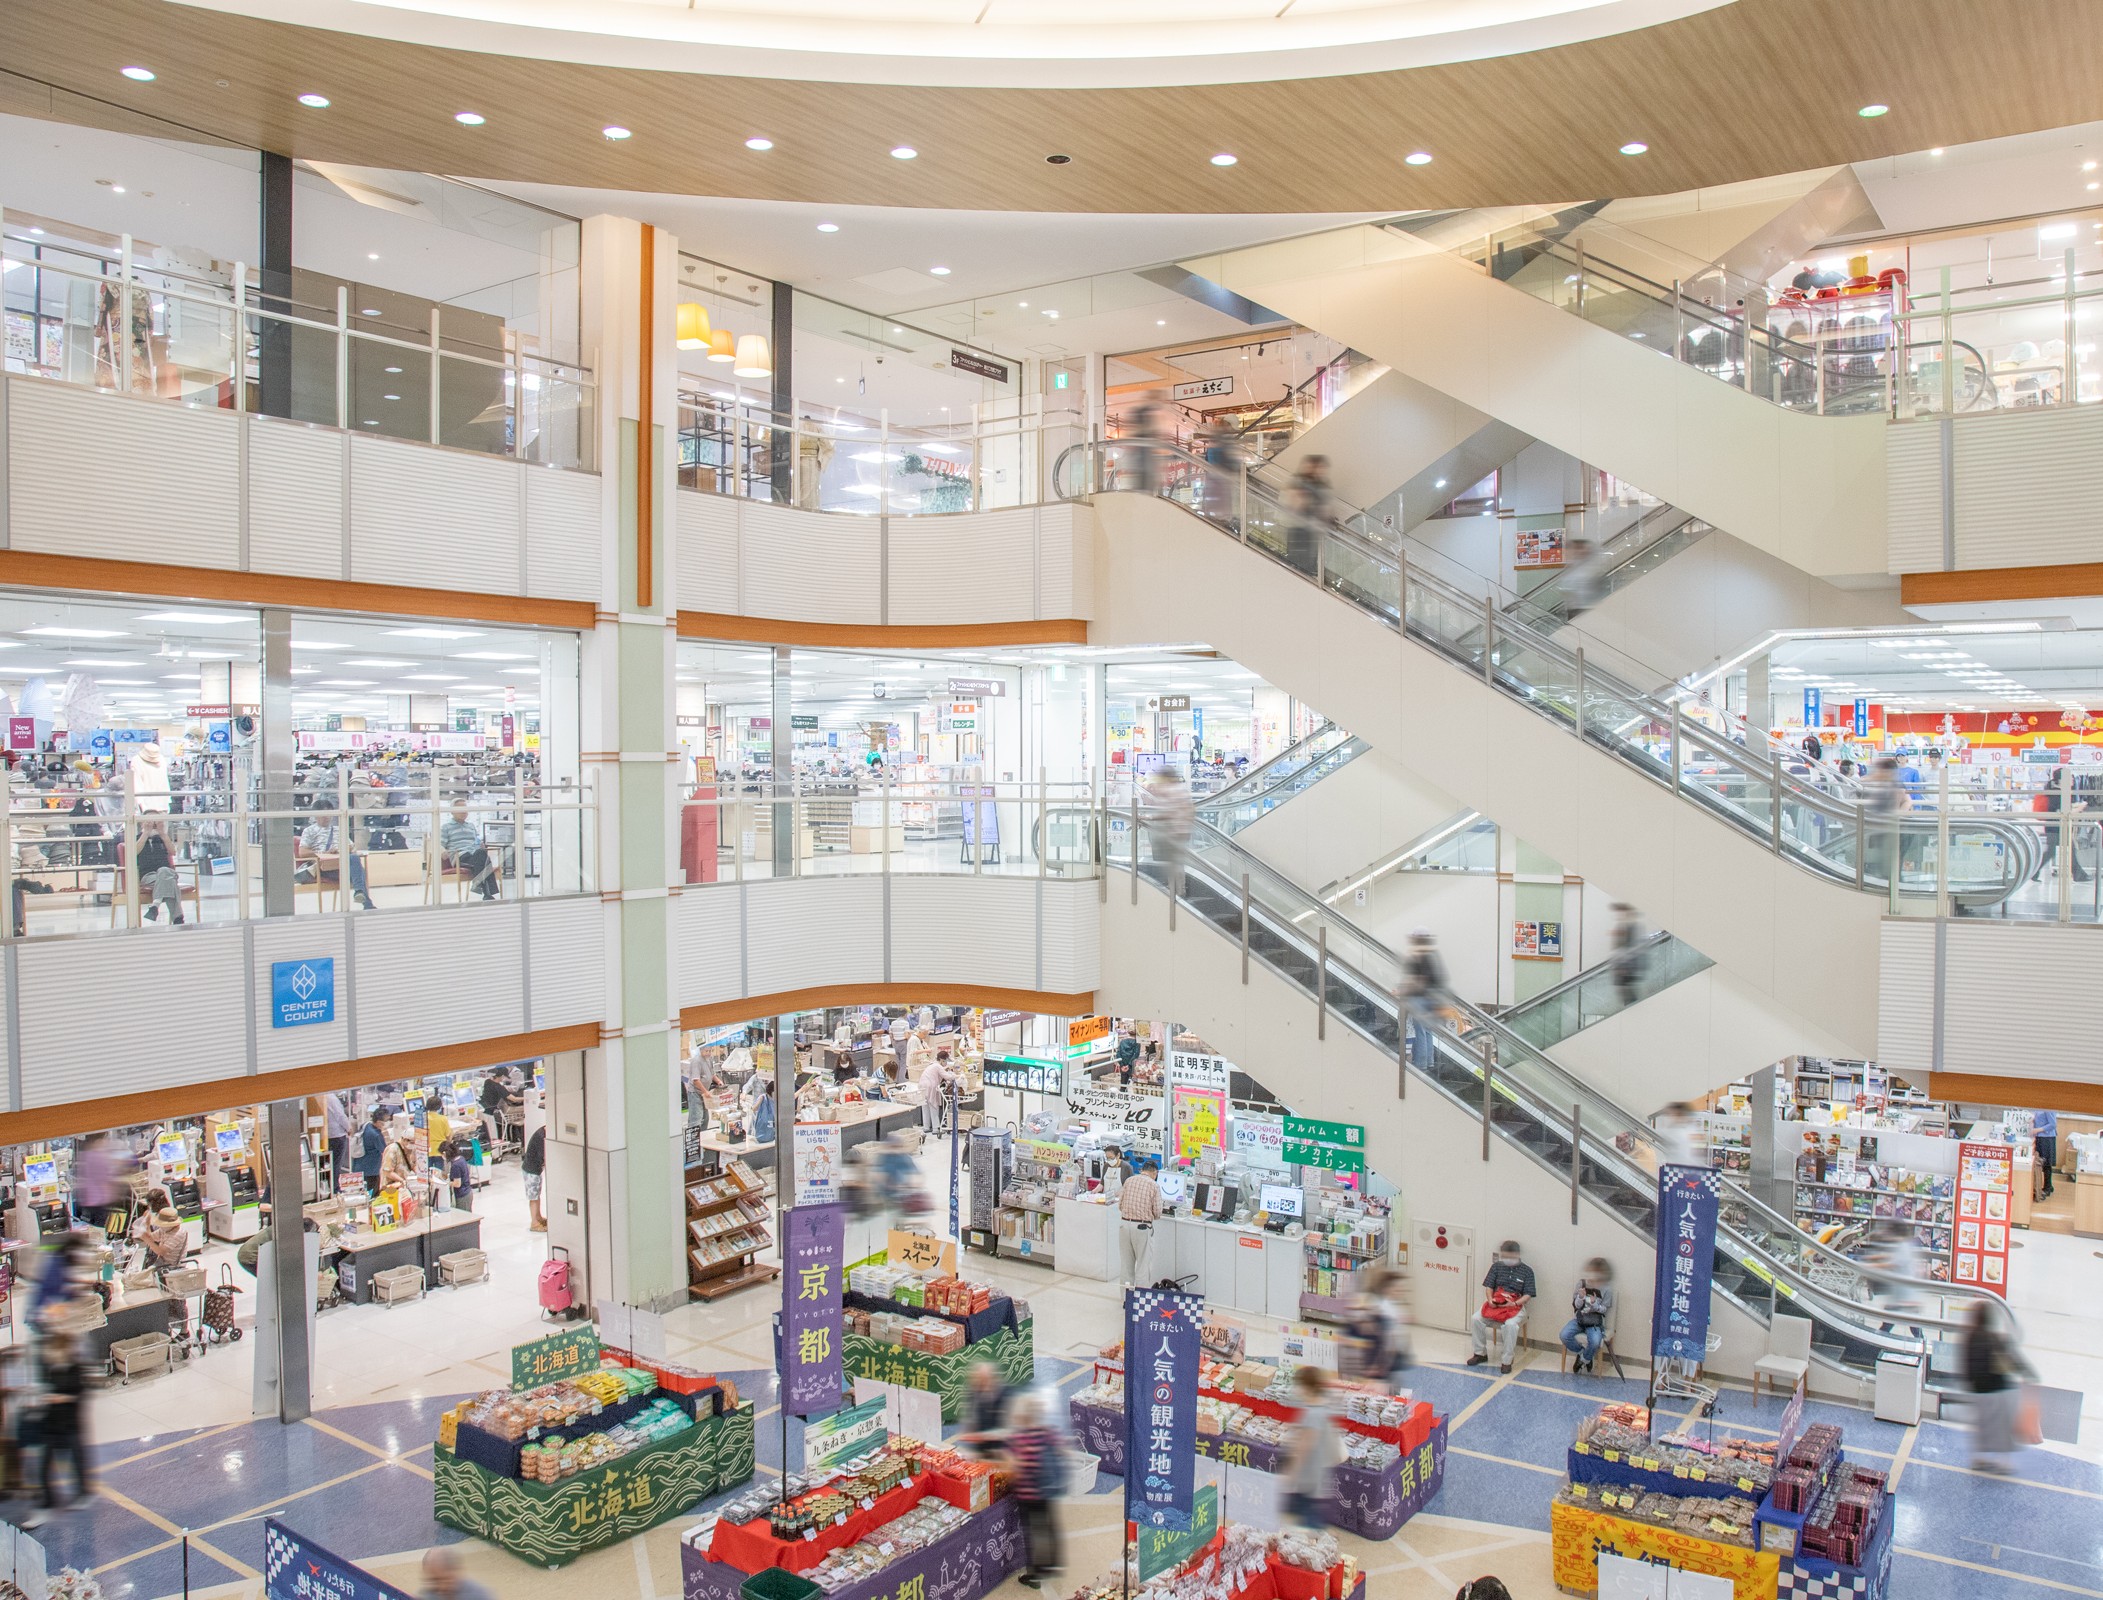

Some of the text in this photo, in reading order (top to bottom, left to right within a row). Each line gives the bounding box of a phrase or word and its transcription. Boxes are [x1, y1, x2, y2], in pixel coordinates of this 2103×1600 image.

[1202, 381, 1223, 394] えちご
[1164, 698, 1186, 707] お会計
[199, 707, 229, 716] CASHIER
[2010, 724, 2029, 732] AME
[321, 735, 345, 743] Casual
[443, 736, 469, 745] Walking
[1990, 752, 2001, 761] 10
[2091, 752, 2102, 761] 10
[1543, 924, 1557, 938] 薬
[281, 1000, 327, 1012] CENTER
[284, 1010, 325, 1022] COURT
[1070, 1016, 1109, 1039] マイナンバー写真
[1174, 1055, 1224, 1073] 証明写真
[1085, 1097, 1131, 1110] プリントショップ
[1124, 1108, 1154, 1123] ヒロ
[1193, 1125, 1216, 1133] 承ります
[1287, 1122, 1359, 1144] アルバム・額
[1189, 1135, 1209, 1143] 約20分
[1286, 1143, 1333, 1157] デジカメ
[1312, 1157, 1360, 1171] プリント
[1677, 1190, 1705, 1200] 行きたい
[912, 1241, 931, 1252] 北海道
[902, 1248, 941, 1267] スイーツ
[1672, 1202, 1698, 1313] 人気の観光地
[794, 1307, 835, 1320] KYOTO
[798, 1263, 831, 1365] 京都
[1149, 1321, 1184, 1333] 行きたい
[532, 1343, 580, 1375] 北海道
[859, 1356, 930, 1390] 北海道
[1148, 1336, 1176, 1476] 人気の観光地
[812, 1414, 883, 1458] 九条ねぎ・京惣菜
[1400, 1441, 1434, 1501] 京都
[568, 1473, 655, 1533] 北海道
[1146, 1492, 1173, 1503] 物産展
[1152, 1503, 1208, 1555] 京の茶
